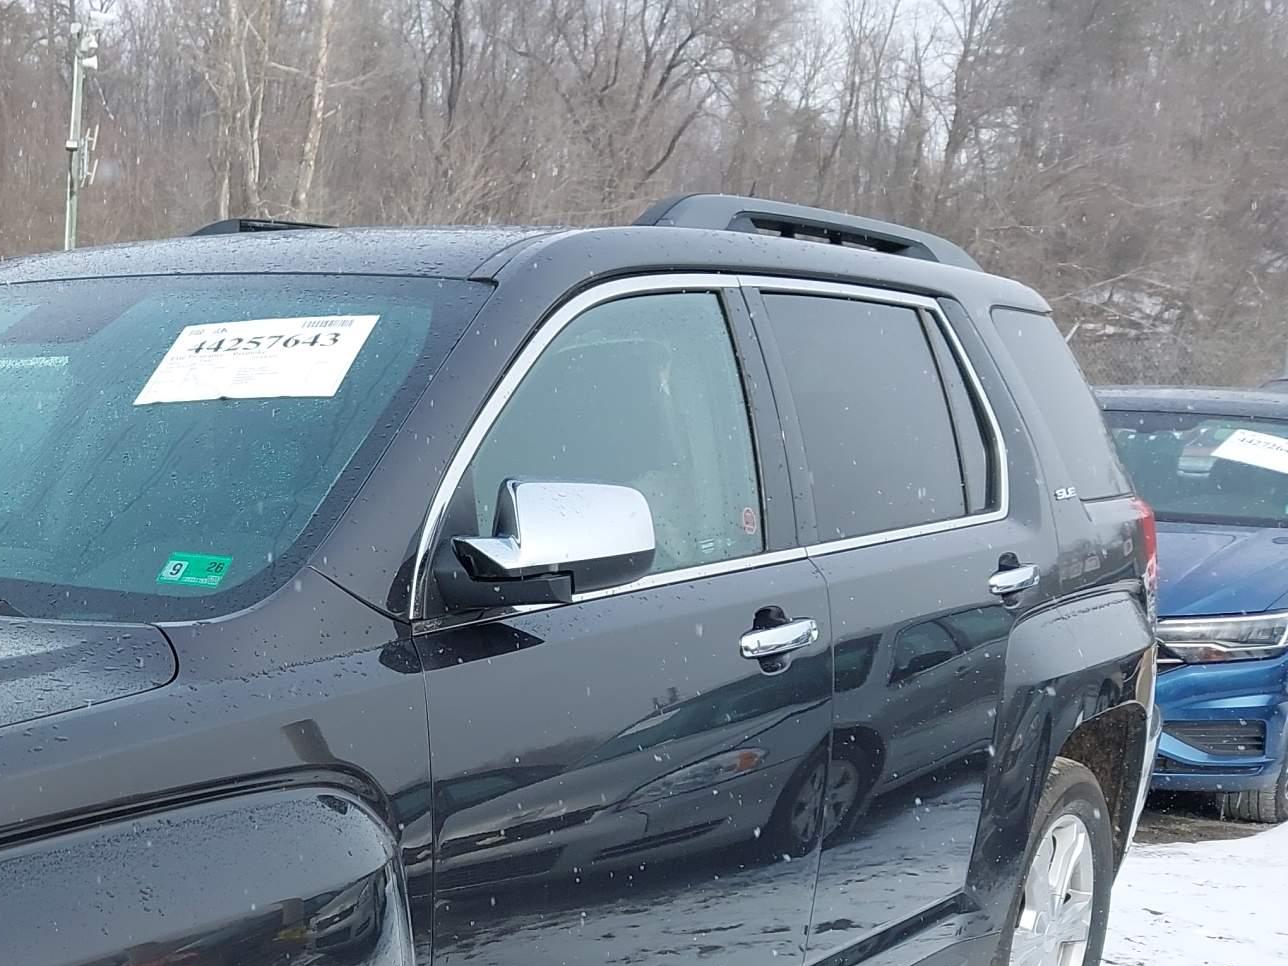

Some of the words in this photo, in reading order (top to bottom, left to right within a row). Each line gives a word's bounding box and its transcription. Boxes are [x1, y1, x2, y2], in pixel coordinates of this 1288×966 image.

[189, 332, 341, 355] 44257643
[1055, 486, 1077, 500] SLE
[169, 562, 184, 576] 9
[206, 561, 225, 574] 26
